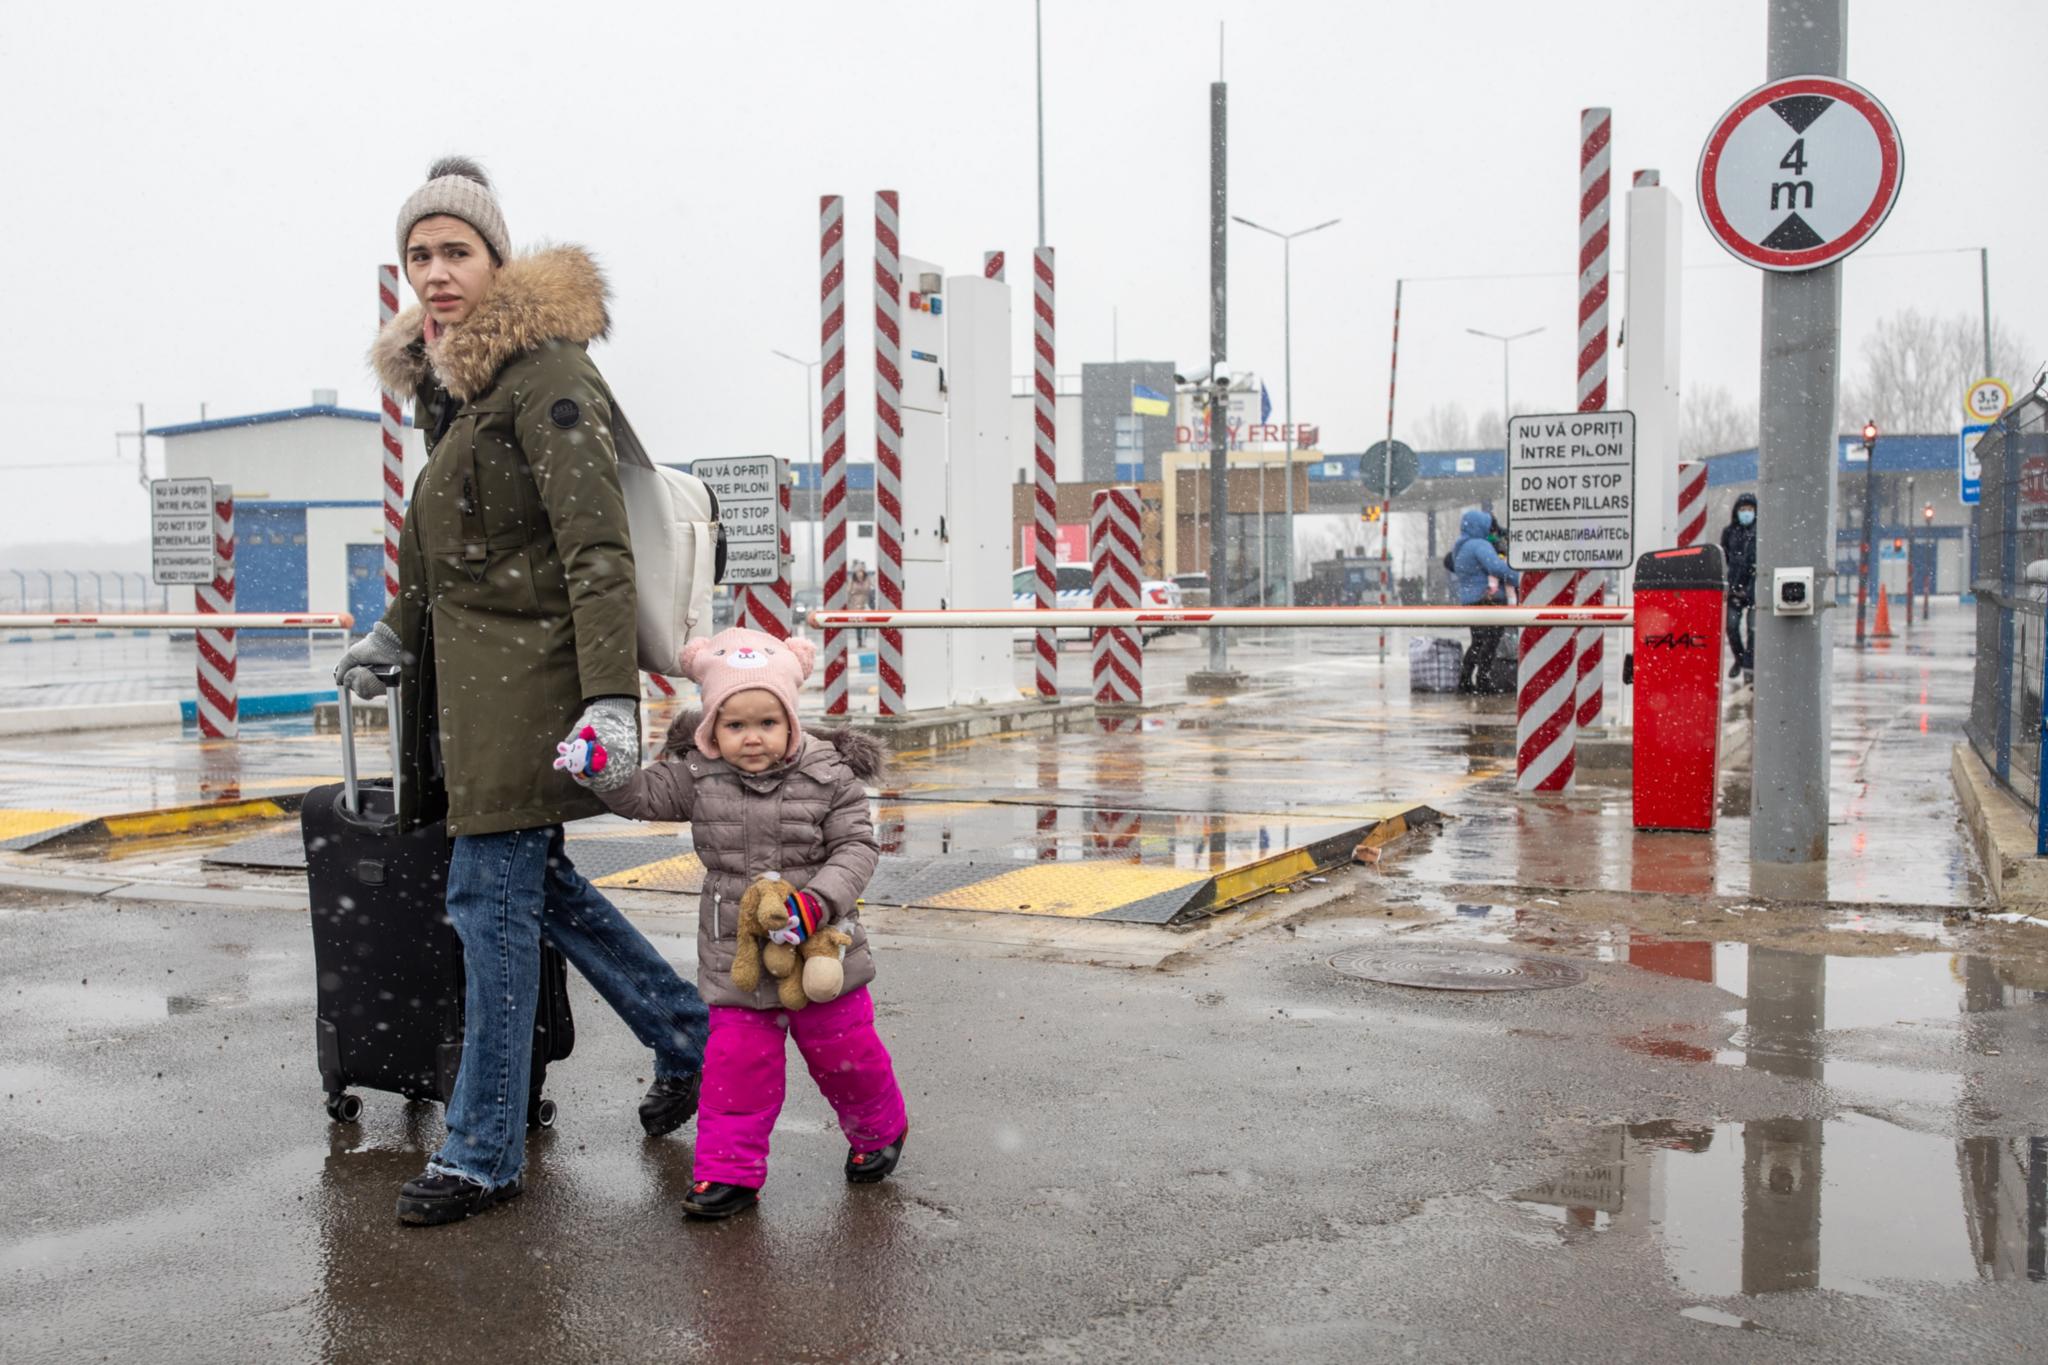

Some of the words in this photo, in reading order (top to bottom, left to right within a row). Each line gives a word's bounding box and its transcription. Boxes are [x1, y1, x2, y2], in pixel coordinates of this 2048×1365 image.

[1779, 138, 1808, 175] 4
[1770, 180, 1814, 211] m
[1977, 389, 1999, 405] 3,5
[1175, 425, 1241, 446] DUY
[1248, 423, 1312, 443] FREE
[1519, 425, 1540, 439] NU
[1545, 421, 1567, 437] VĂ
[1521, 444, 1566, 459] ÎNTRE
[1571, 443, 1623, 458] PILONI
[698, 467, 712, 478] NU
[733, 482, 769, 493] PILONI
[1521, 476, 1543, 491] DO
[1546, 475, 1577, 490] NOT
[1582, 474, 1622, 489] STOP
[1512, 497, 1571, 512] BETWEEN
[1573, 495, 1629, 510] PILLARS
[742, 507, 769, 519] STOP
[170, 521, 186, 531] NOT
[188, 521, 207, 531] STOP
[736, 524, 775, 536] PILLARS
[1510, 529, 1523, 542] НЕ
[1525, 526, 1630, 542] ОСТАНАВЛИВАЙТЕСЬ
[1522, 550, 1561, 564] МЕЖДУ
[1563, 549, 1623, 562] СТОЛБАМИ
[1644, 632, 1712, 649] FAAC
